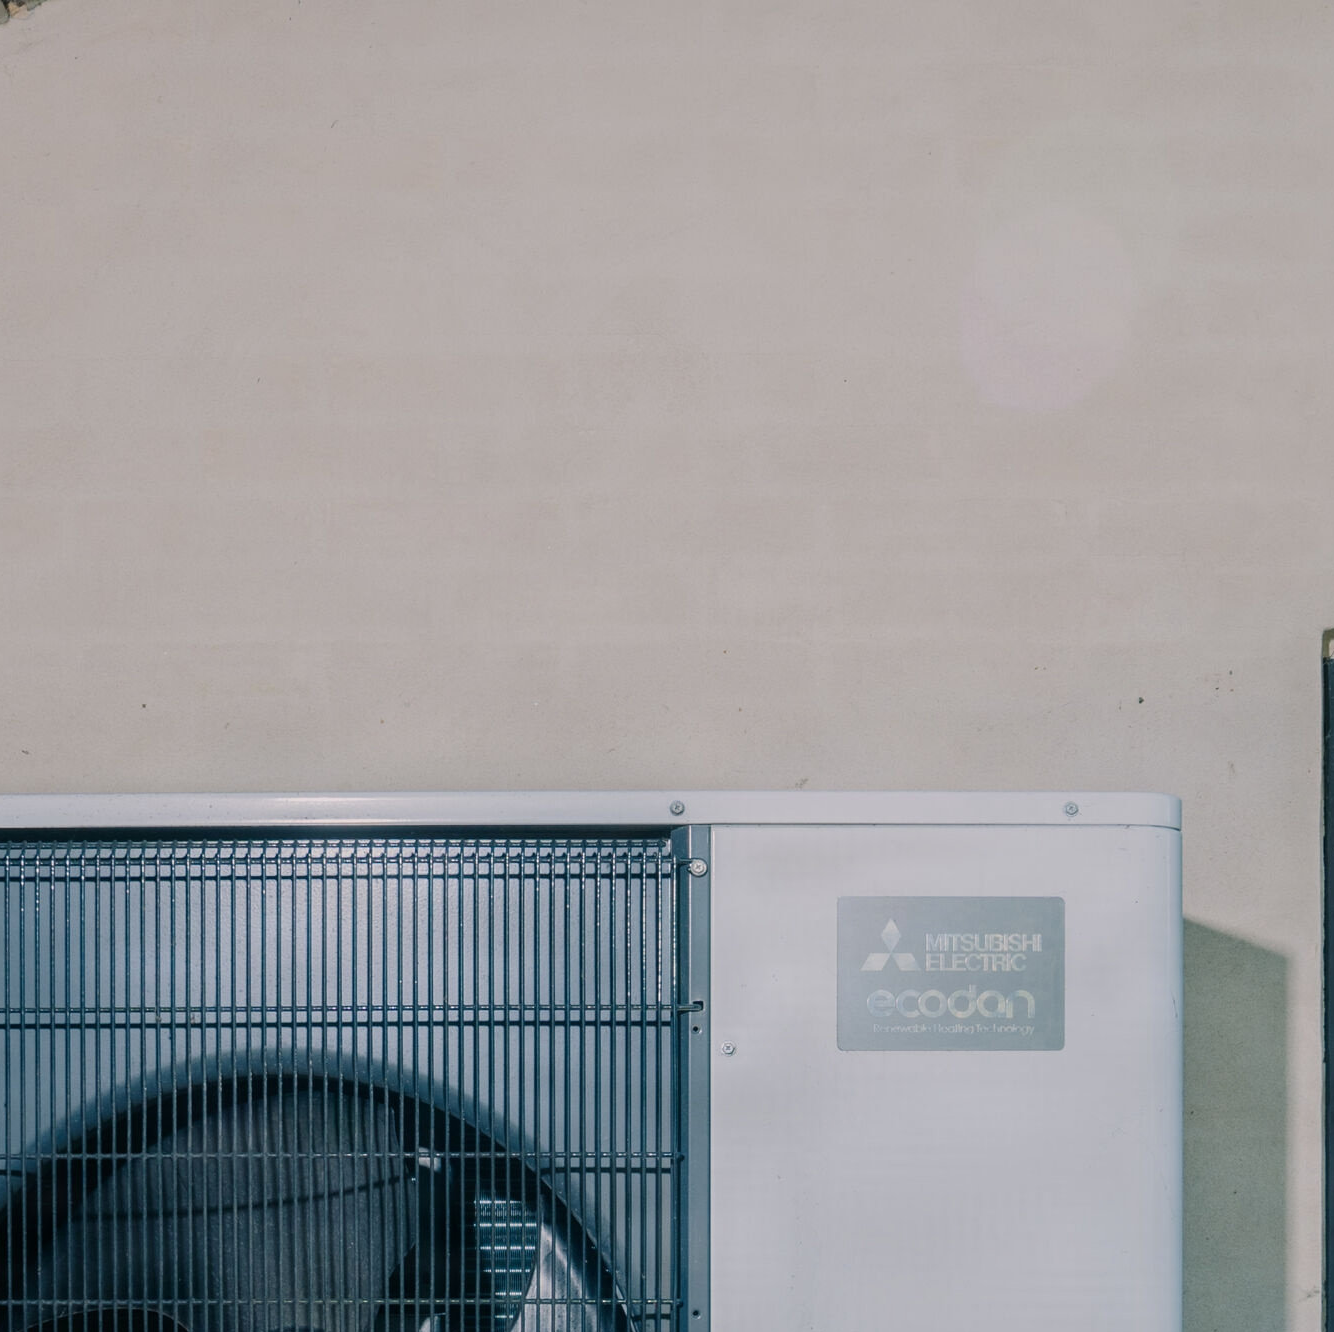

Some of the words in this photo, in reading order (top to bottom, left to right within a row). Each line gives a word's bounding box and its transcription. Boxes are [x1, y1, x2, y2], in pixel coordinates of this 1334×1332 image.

[925, 932, 1043, 953] MITSUBISHI
[925, 952, 1028, 972] ELECTRIC
[866, 984, 1036, 1019] ecodan
